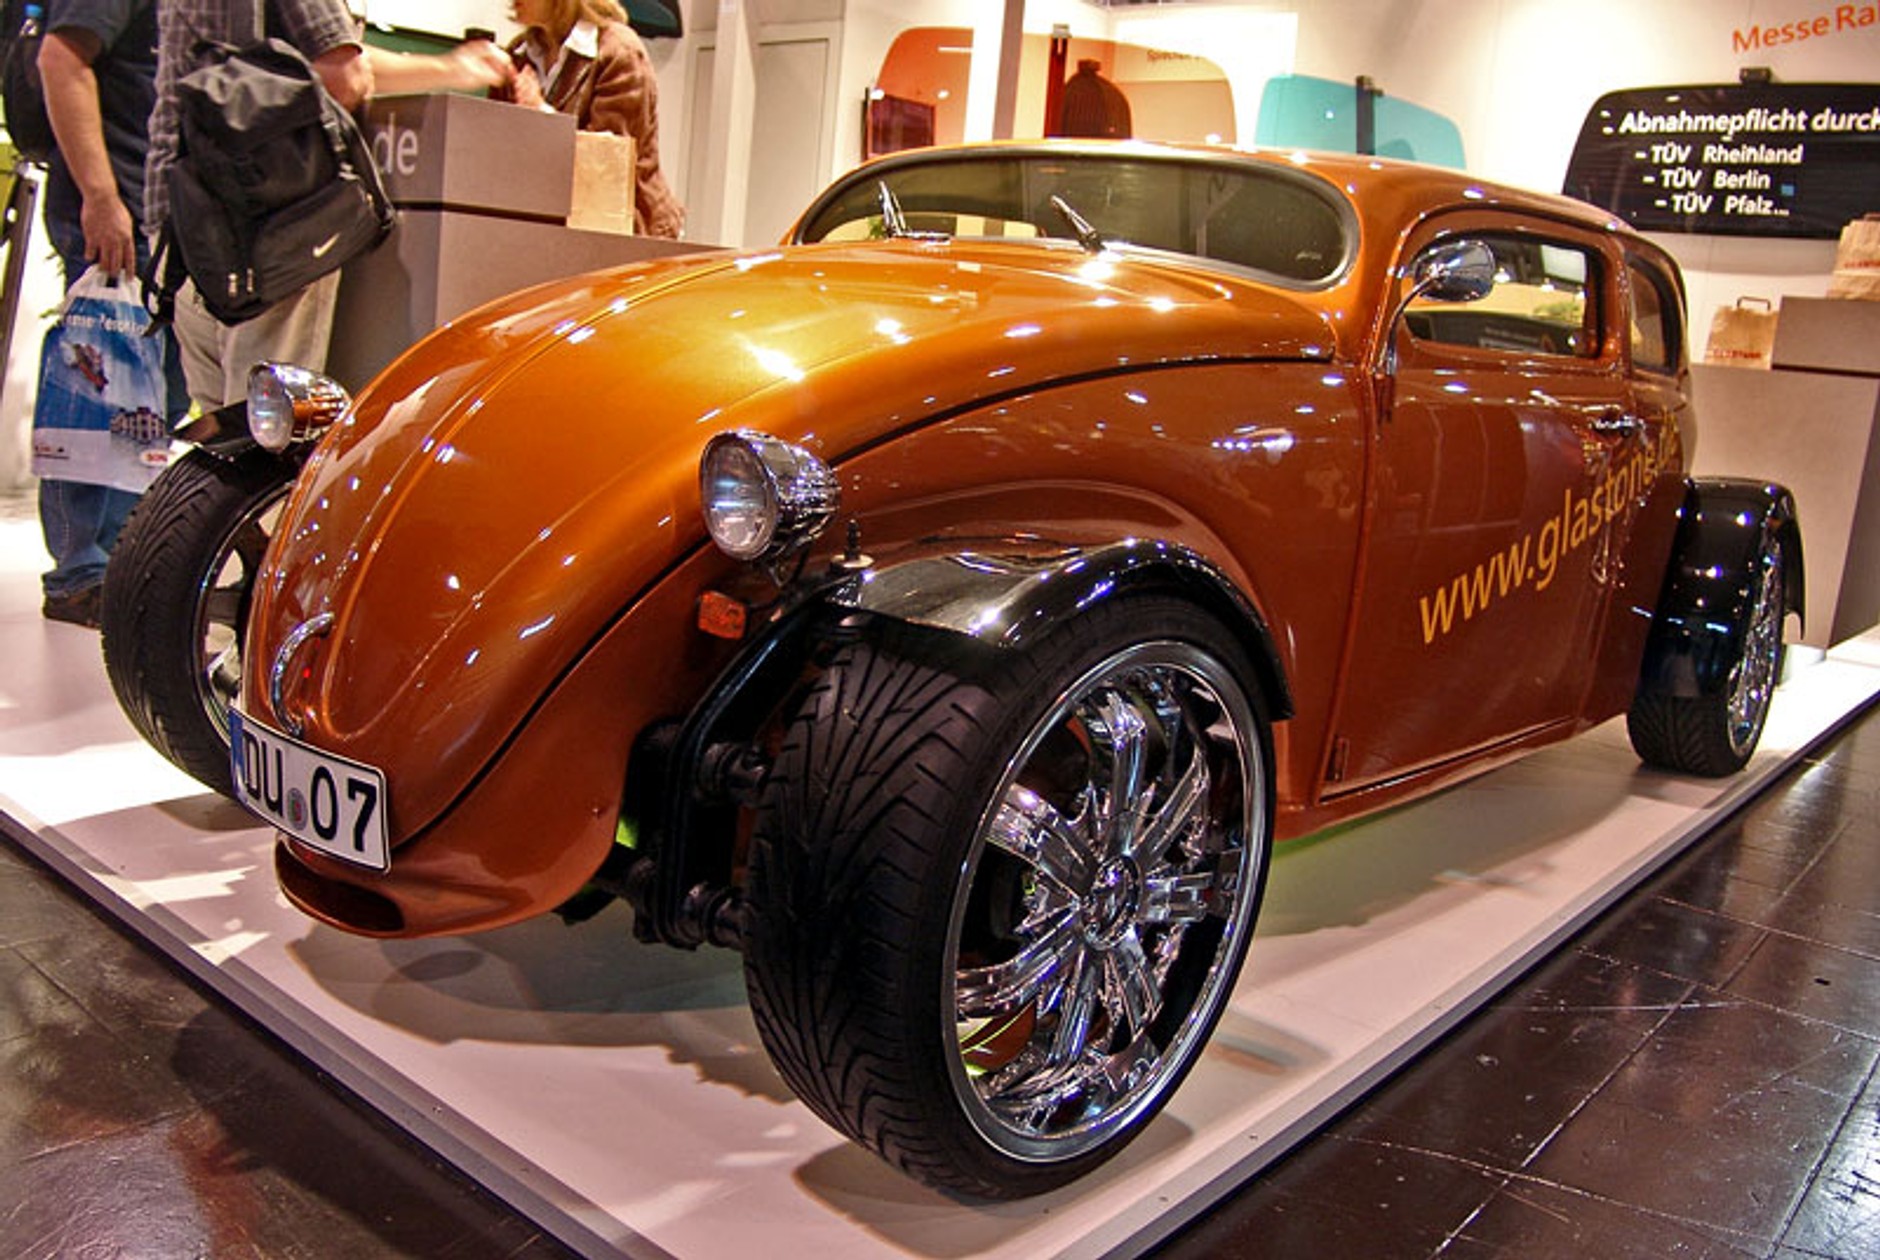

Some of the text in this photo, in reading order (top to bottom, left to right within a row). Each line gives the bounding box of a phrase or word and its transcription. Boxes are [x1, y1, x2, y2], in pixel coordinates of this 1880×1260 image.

[1732, 0, 1880, 53] Messe Ra
[1618, 108, 1807, 138] Abnahmepflicht
[1651, 141, 1692, 163] TÜV
[1702, 144, 1804, 164] Rheinland
[1661, 167, 1703, 188] TÜV
[1713, 170, 1771, 189] Berlin
[1671, 191, 1713, 213] TÜV
[243, 729, 377, 852] DU 07
